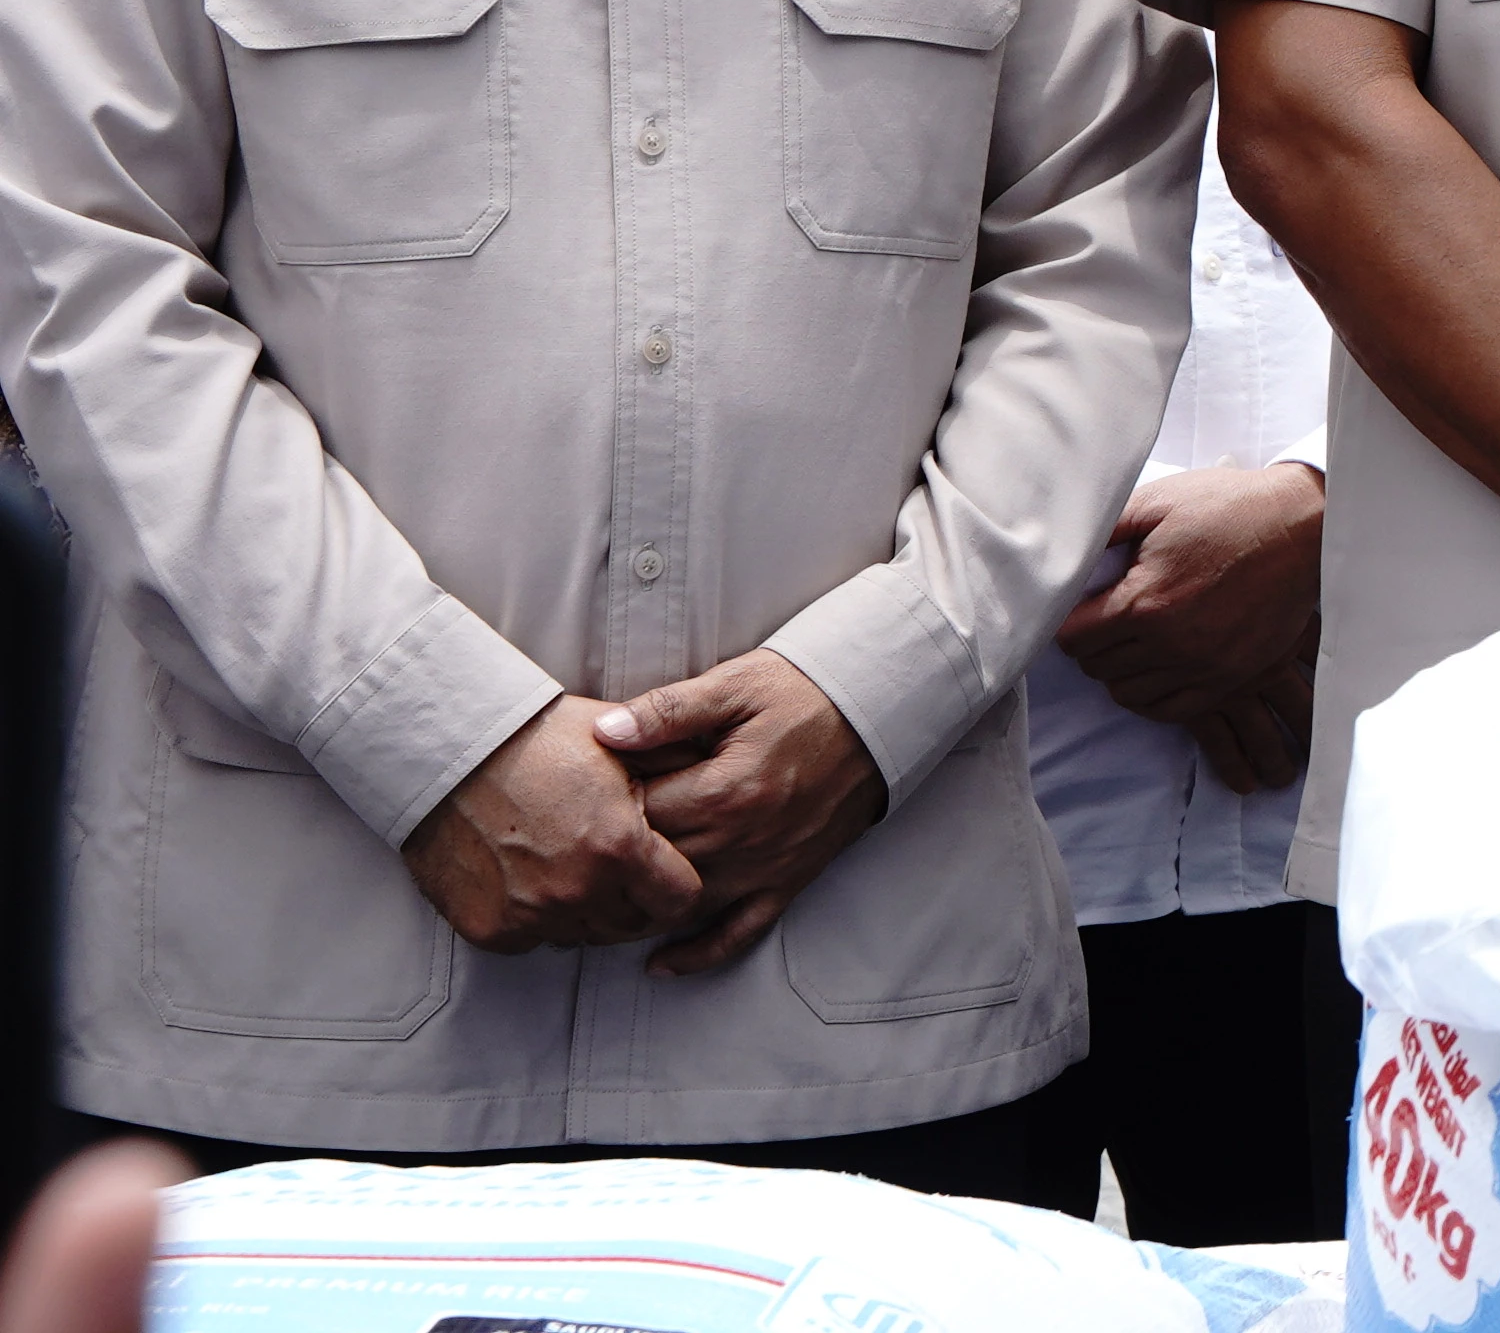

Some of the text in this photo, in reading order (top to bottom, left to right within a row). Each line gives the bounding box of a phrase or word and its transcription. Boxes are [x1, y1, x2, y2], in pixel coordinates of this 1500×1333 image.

[1364, 1055, 1476, 1281] 40kg
[233, 1275, 591, 1304] PREMIUM RICE
